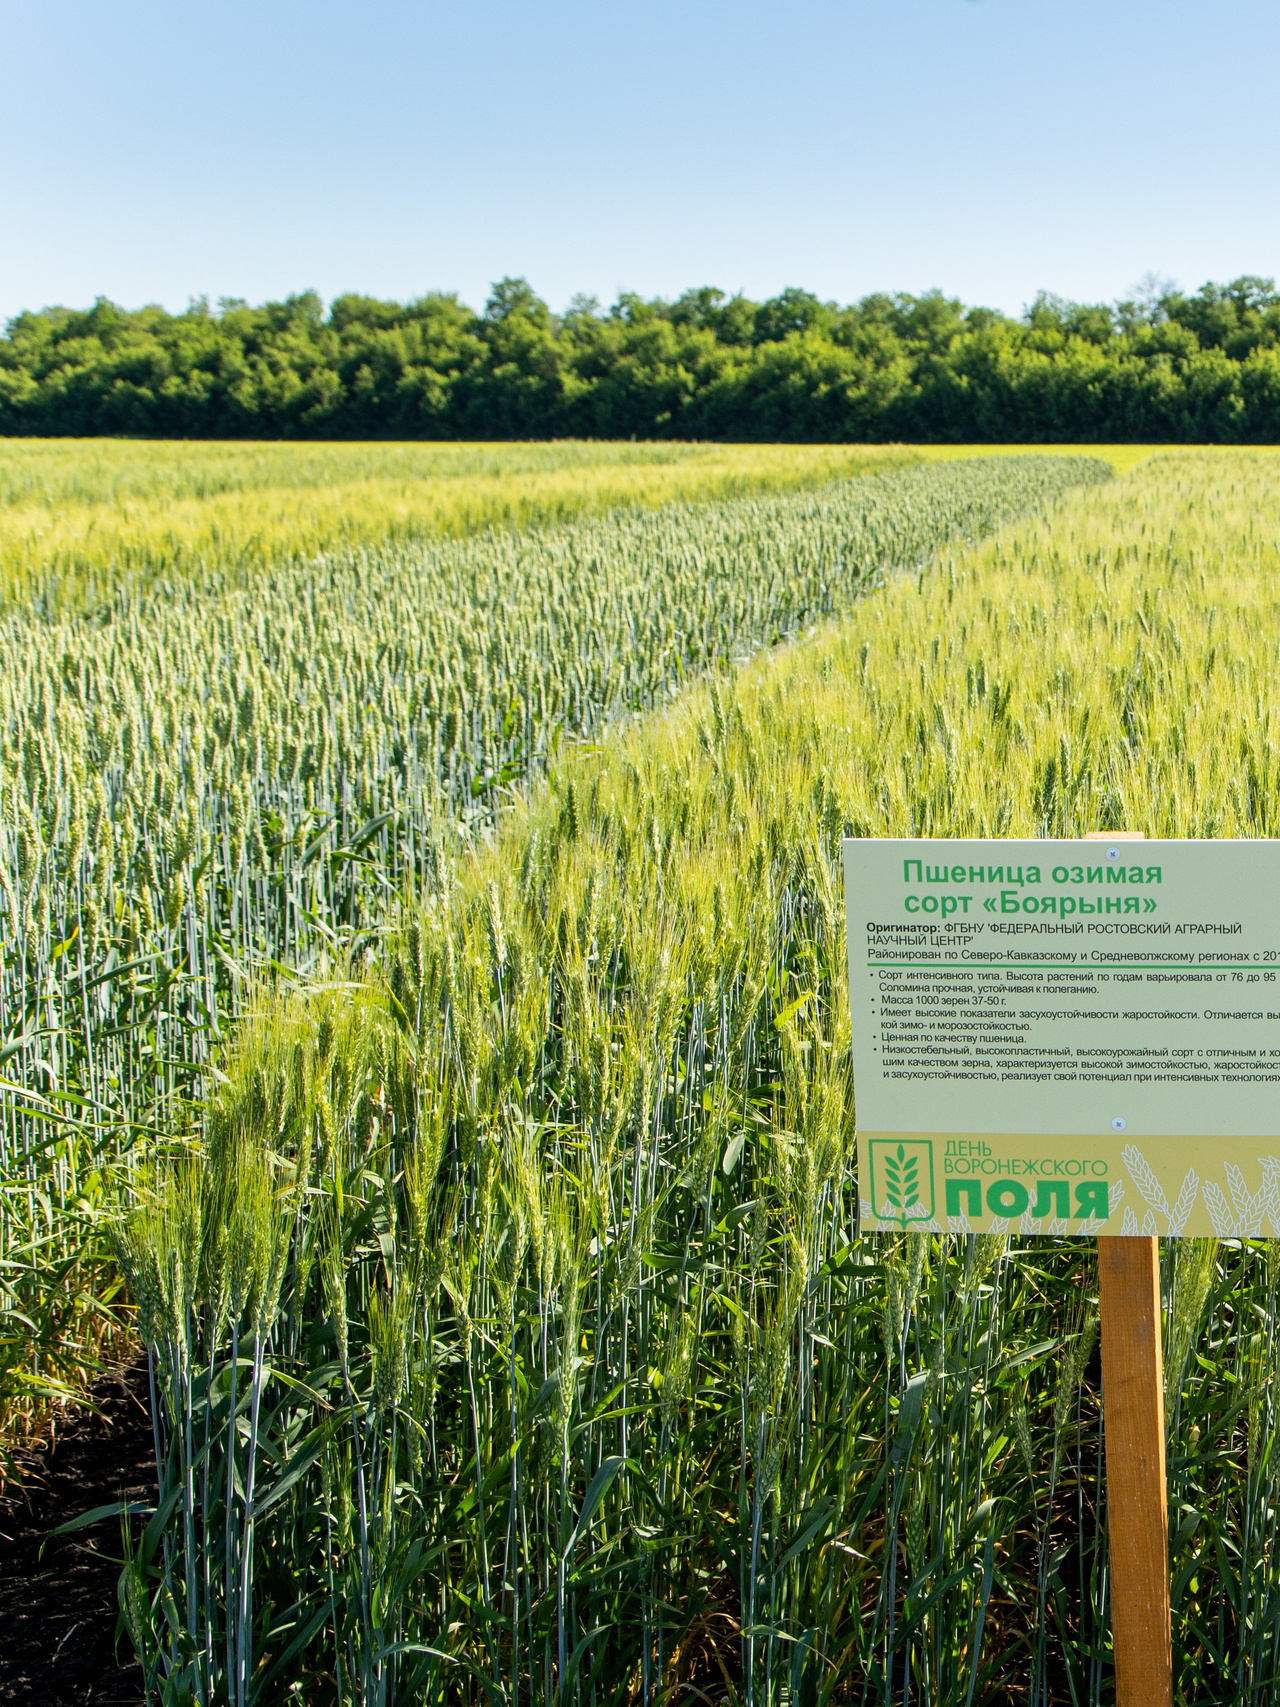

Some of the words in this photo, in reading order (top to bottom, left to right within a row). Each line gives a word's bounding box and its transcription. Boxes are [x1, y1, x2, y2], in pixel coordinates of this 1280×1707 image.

[904, 860, 1041, 887] Пшеница
[1052, 866, 1161, 883] озимая
[905, 896, 972, 918] сорт
[983, 891, 1157, 919] «Боярыня»
[867, 922, 940, 935] Оригинатор:
[944, 923, 984, 933] ФГБНУ
[988, 922, 1083, 935] 'ФЕДЕРАЛЬНЫЙ
[1088, 922, 1171, 934] РОСТОВСКИЙ
[1175, 922, 1241, 934] АГРАРНЫЙ
[867, 934, 926, 945] НАУЧНЫЙ
[931, 936, 973, 948] ЦЕНТР'
[868, 949, 941, 961] Районирован
[961, 949, 1077, 962] Северо-Кавказскому
[1091, 950, 1195, 963] Средневолжскому
[1199, 953, 1249, 963] регионах
[1253, 953, 1259, 961] с
[879, 970, 903, 981] Сорт
[1006, 971, 1043, 981] Высота
[1047, 972, 1093, 982] растений
[1113, 974, 1142, 982] годам
[1147, 974, 1212, 983] варьировала
[1231, 972, 1243, 981] 76
[1246, 974, 1260, 983] до
[1263, 972, 1276, 981] 95
[879, 982, 930, 992] Соломина
[932, 985, 975, 994] прочная,
[977, 984, 1034, 995] устойчивая
[882, 995, 913, 1004] Масса
[916, 995, 939, 1005] 1000
[941, 998, 970, 1007] зерен
[972, 996, 999, 1005] 37-50
[881, 1007, 912, 1017] Имеет
[960, 1010, 1015, 1018] показатели
[1019, 1010, 1118, 1020] засухоустойчивости
[1122, 1010, 1200, 1020] жаростойкости.
[1204, 1010, 1263, 1019] Отличается
[881, 1020, 897, 1029] кой
[938, 1021, 1032, 1031] морозостойкостью.
[882, 1032, 918, 1043] Ценная
[935, 1035, 977, 1044] качеству
[980, 1036, 1026, 1044] пшеница.
[882, 1045, 972, 1056] Низкостебельный,
[976, 1047, 1073, 1057] высокопластичный,
[1076, 1048, 1168, 1058] высокоурожайный
[1172, 1050, 1194, 1058] сорт
[908, 1059, 958, 1067] качеством
[962, 1060, 992, 1069] зерна,
[996, 1060, 1078, 1070] характеризуется
[1081, 1060, 1123, 1068] высокой
[1126, 1060, 1210, 1070] зимостойкостью,
[891, 1070, 999, 1081] засухоустойчивостью,
[1002, 1073, 1052, 1082] реализует
[1054, 1072, 1077, 1080] свой
[1079, 1074, 1131, 1082] потенциал
[1134, 1074, 1152, 1083] при
[944, 1140, 992, 1157] ДЕНЬ
[944, 1158, 1108, 1176] ВОРОНЕЖСКОГО
[945, 1179, 1109, 1219] ПОЛЯ
